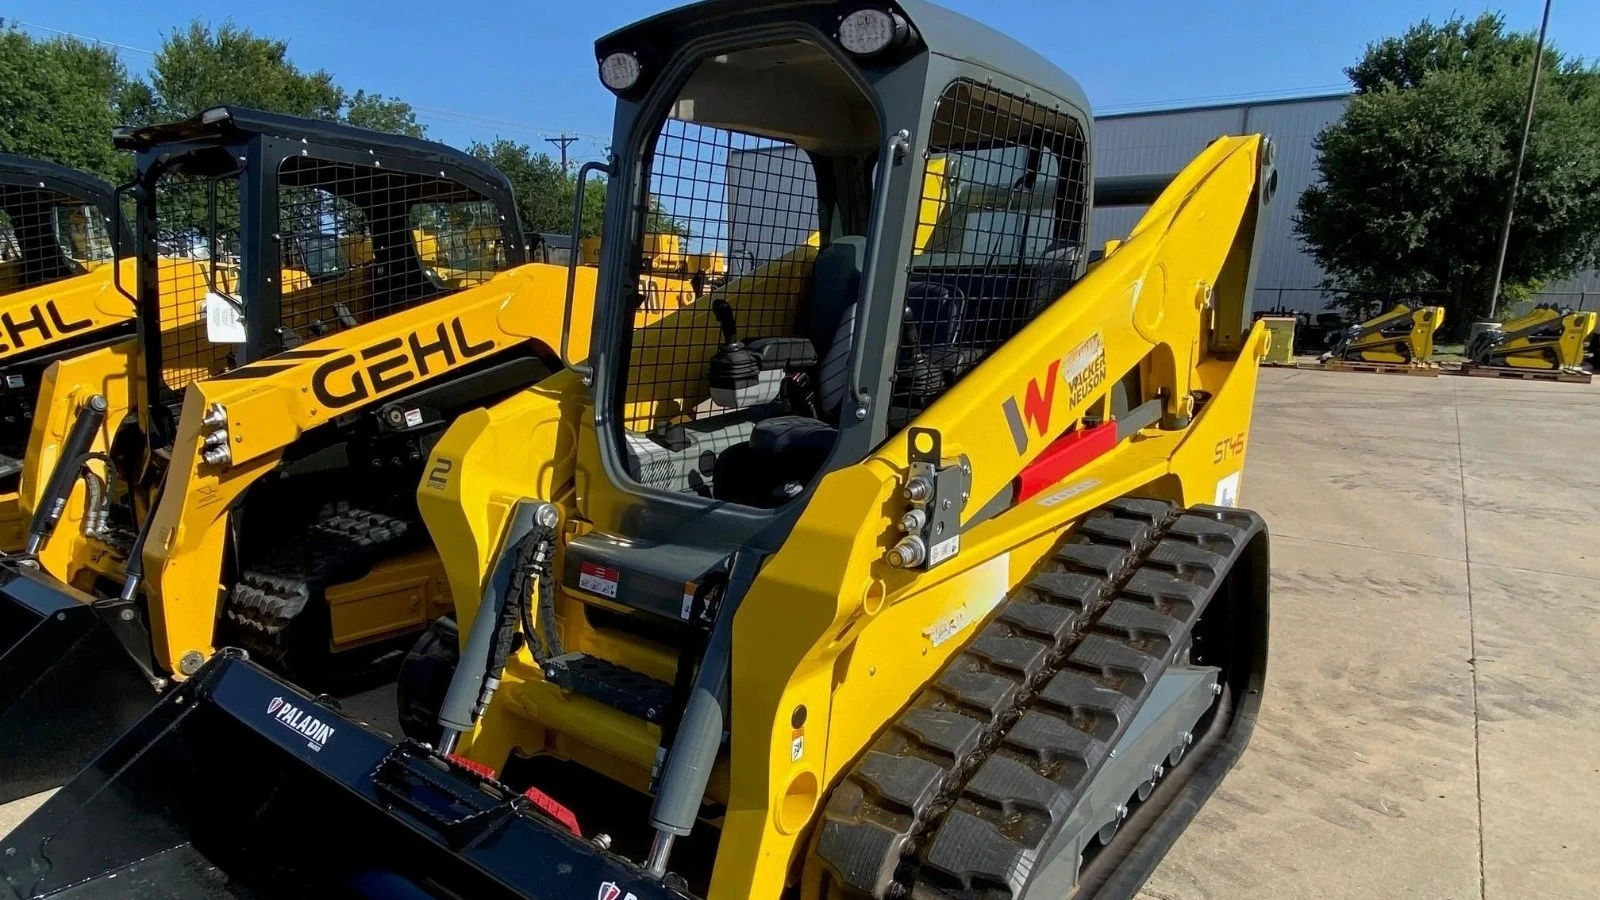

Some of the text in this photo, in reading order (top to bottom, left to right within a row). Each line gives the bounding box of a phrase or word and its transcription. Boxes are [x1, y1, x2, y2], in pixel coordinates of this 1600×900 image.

[0, 299, 93, 354] HL
[311, 315, 496, 409] GEHL
[1068, 347, 1107, 394] WACKER
[1068, 366, 1107, 411] NEUSON
[429, 457, 453, 484] 2
[1213, 432, 1245, 465] ST45
[275, 702, 336, 746] PALADIN
